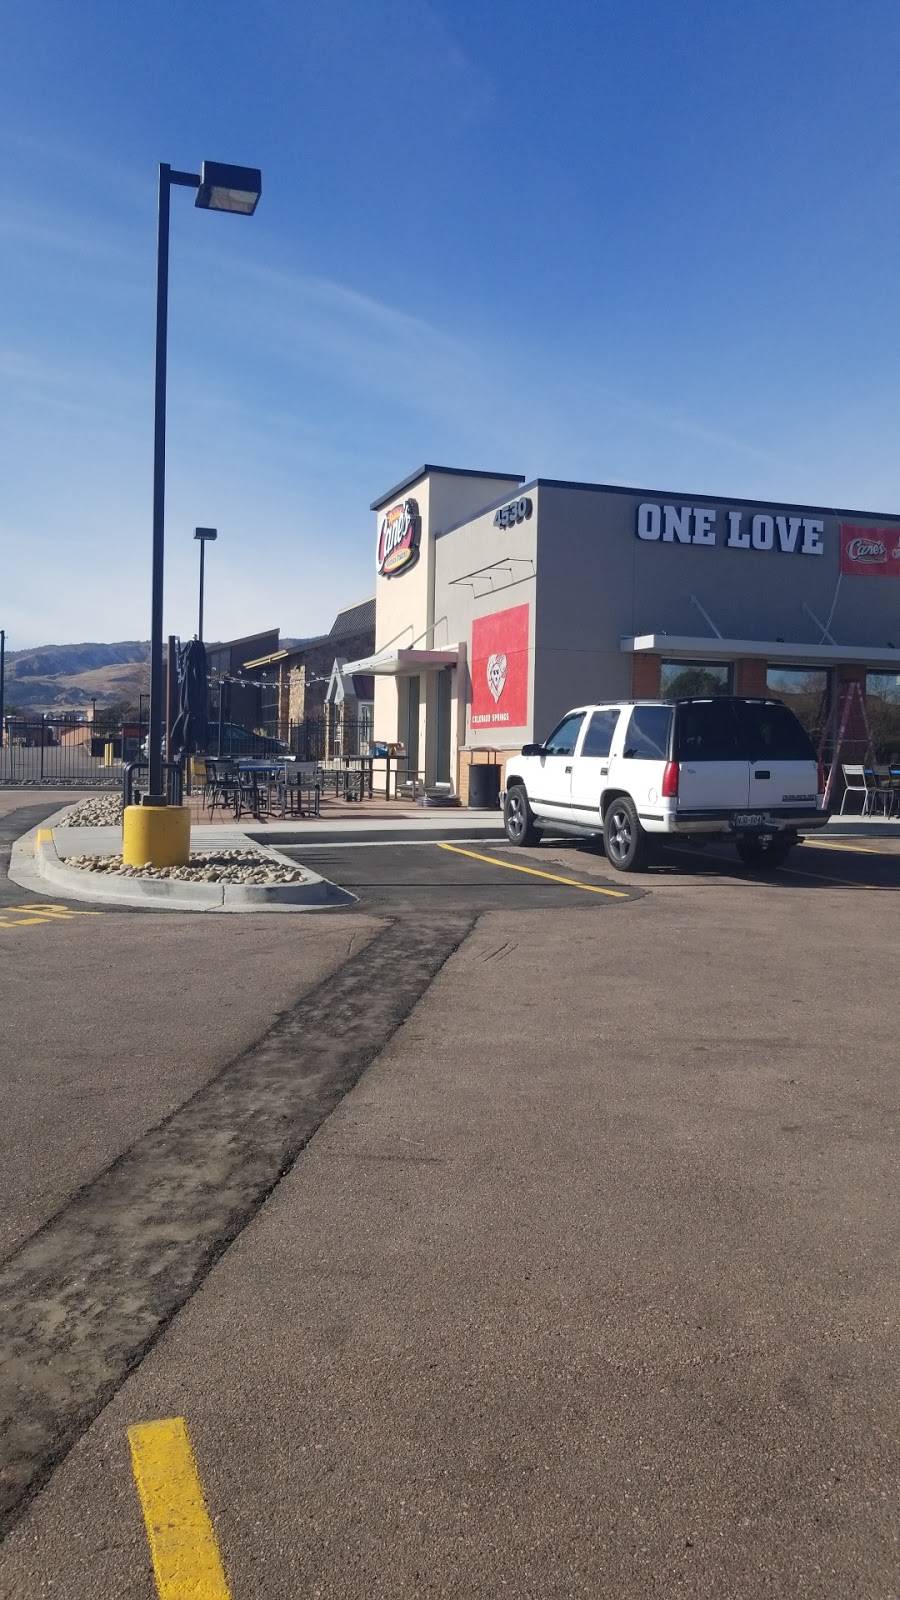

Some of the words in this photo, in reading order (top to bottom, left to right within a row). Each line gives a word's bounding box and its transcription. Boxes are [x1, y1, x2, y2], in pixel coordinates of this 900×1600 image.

[495, 497, 528, 524] 4530
[637, 503, 716, 546] ONE
[727, 511, 824, 555] LOVE
